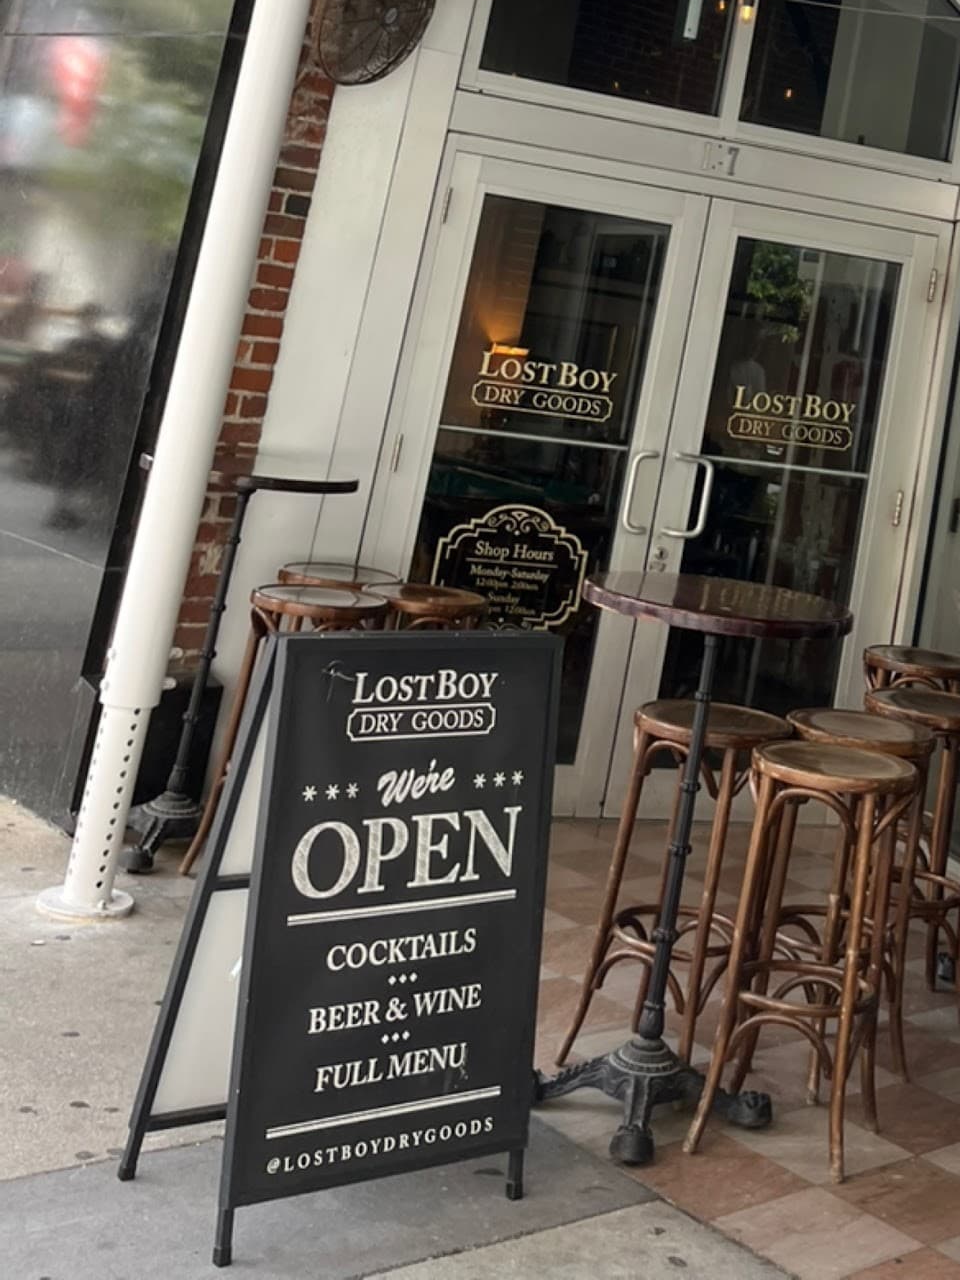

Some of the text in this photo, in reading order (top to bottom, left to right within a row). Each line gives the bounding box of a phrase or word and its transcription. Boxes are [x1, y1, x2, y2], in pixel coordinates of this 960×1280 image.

[484, 386, 602, 415] DRY GOODS
[738, 418, 843, 445] DRY GOODS
[474, 540, 554, 562] Shop Hours
[359, 709, 484, 735] DRY GOODS
[377, 759, 455, 808] We're
[291, 806, 522, 900] OPEN
[327, 928, 477, 972] COCKTAILS
[308, 983, 482, 1035] BEER & WINE
[314, 1043, 467, 1093] FULL MENU
[266, 1116, 495, 1175] @LOSTBOYDRYGOODS
